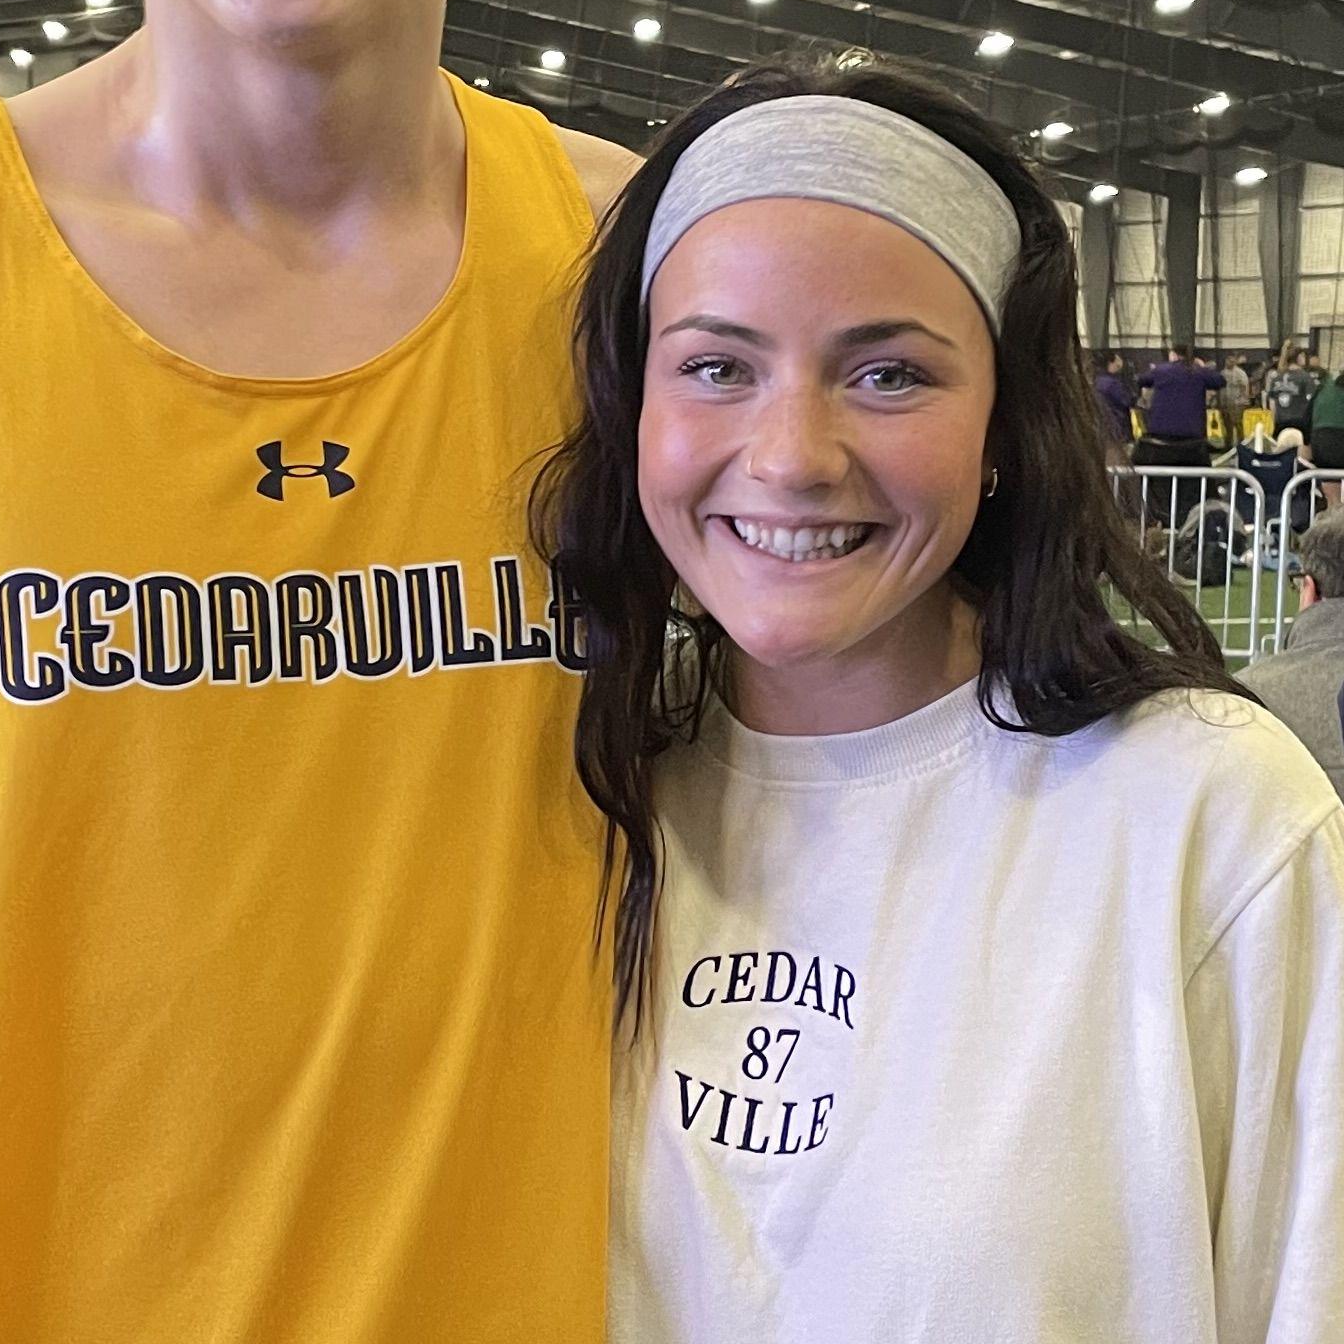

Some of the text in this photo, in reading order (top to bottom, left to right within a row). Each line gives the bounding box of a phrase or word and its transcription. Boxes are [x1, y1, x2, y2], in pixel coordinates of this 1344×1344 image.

[682, 951, 856, 1030] CEDAR
[741, 1026, 801, 1084] 87
[674, 1069, 835, 1155] VILLE
